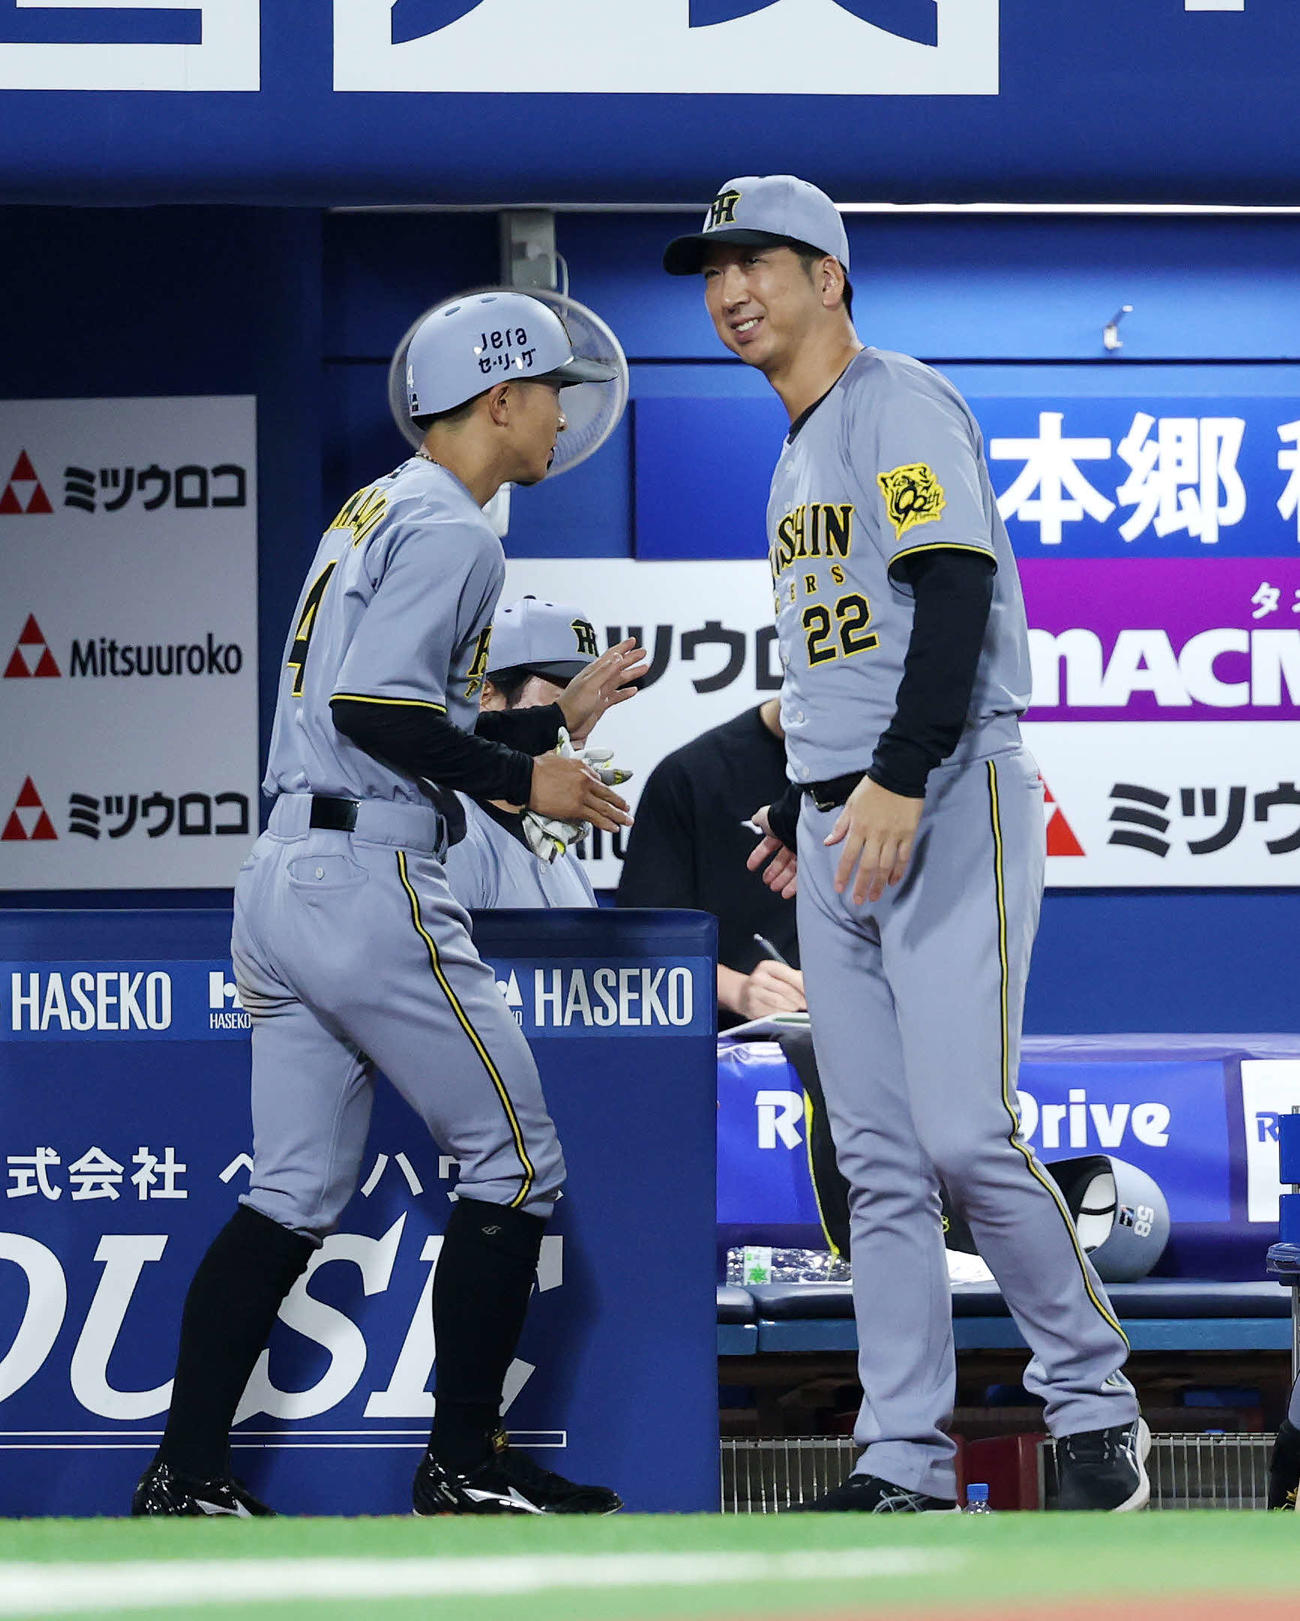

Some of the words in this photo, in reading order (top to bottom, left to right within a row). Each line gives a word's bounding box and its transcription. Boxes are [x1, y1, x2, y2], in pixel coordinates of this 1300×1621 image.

[64, 464, 247, 514] ミツウロコ
[990, 411, 1247, 545] 本郷
[286, 559, 339, 698] 4
[1250, 581, 1300, 620] タ
[70, 633, 243, 678] Mitsuuroko
[802, 592, 881, 668] 22
[68, 791, 249, 840] ミツウロコ
[1107, 782, 1300, 858] ミツウ
[11, 971, 172, 1032] HASEKO
[209, 1013, 251, 1030] HASEKO
[534, 966, 694, 1027] HASEKO
[6, 1145, 189, 1201] 式会社
[1133, 1204, 1155, 1238] 58
